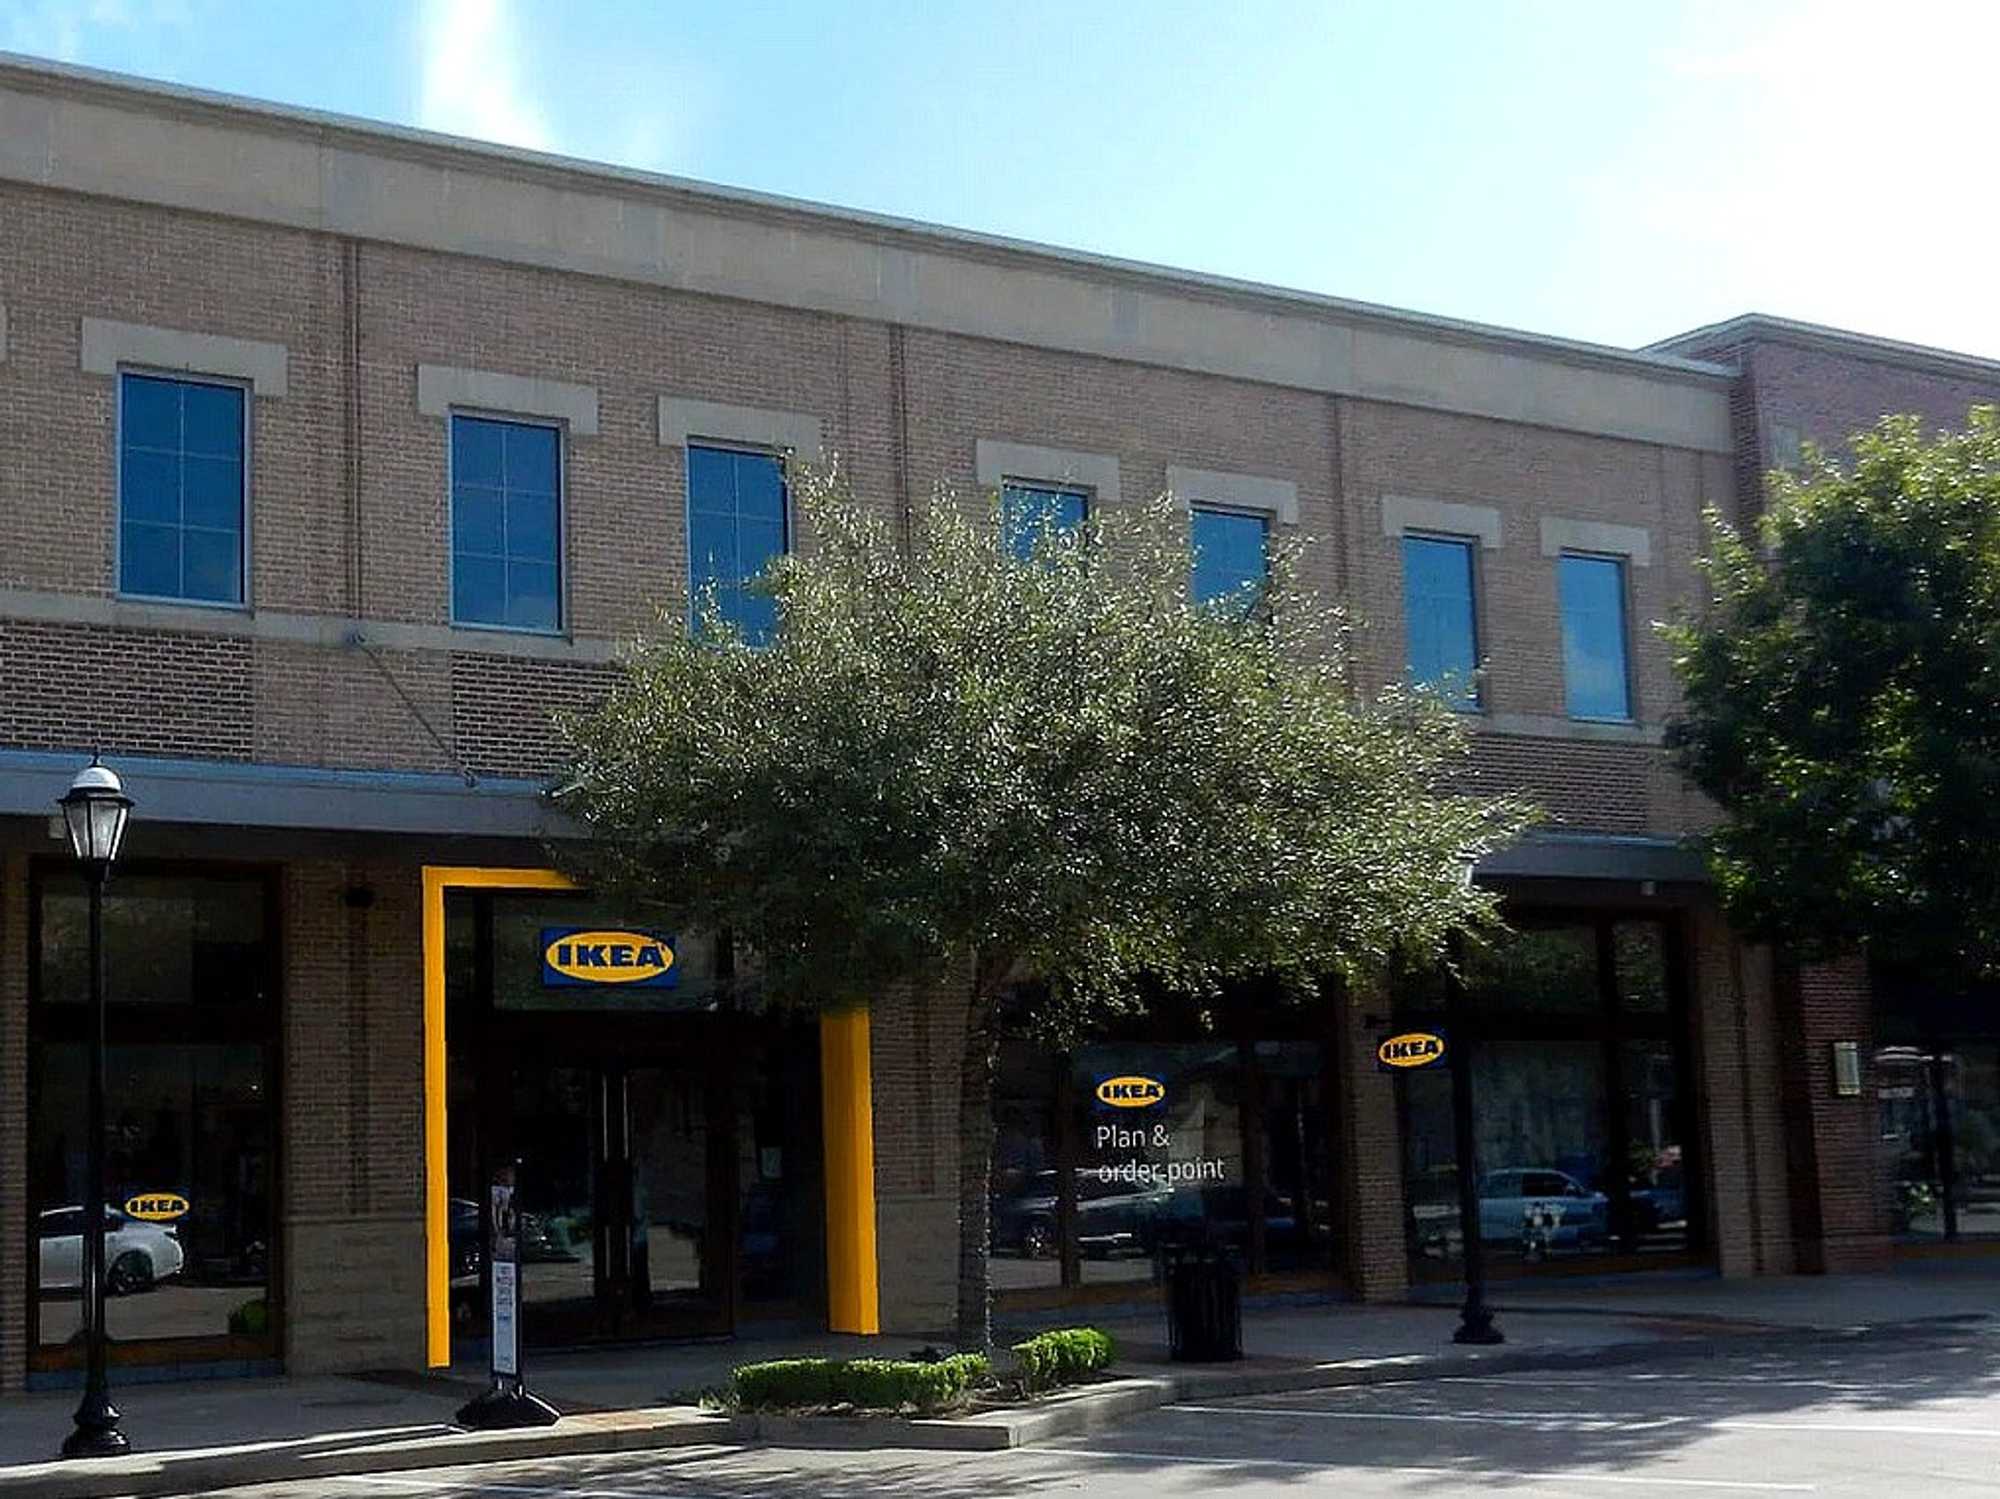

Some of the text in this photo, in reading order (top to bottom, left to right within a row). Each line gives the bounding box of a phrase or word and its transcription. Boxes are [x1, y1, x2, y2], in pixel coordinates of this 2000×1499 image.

[557, 943, 666, 967] IKEA
[1382, 1039, 1440, 1060] IKEA
[1102, 1084, 1160, 1099] IKEA
[1096, 1124, 1170, 1149] Plan &
[1098, 1156, 1226, 1187] order point
[130, 1199, 185, 1213] IKEA
